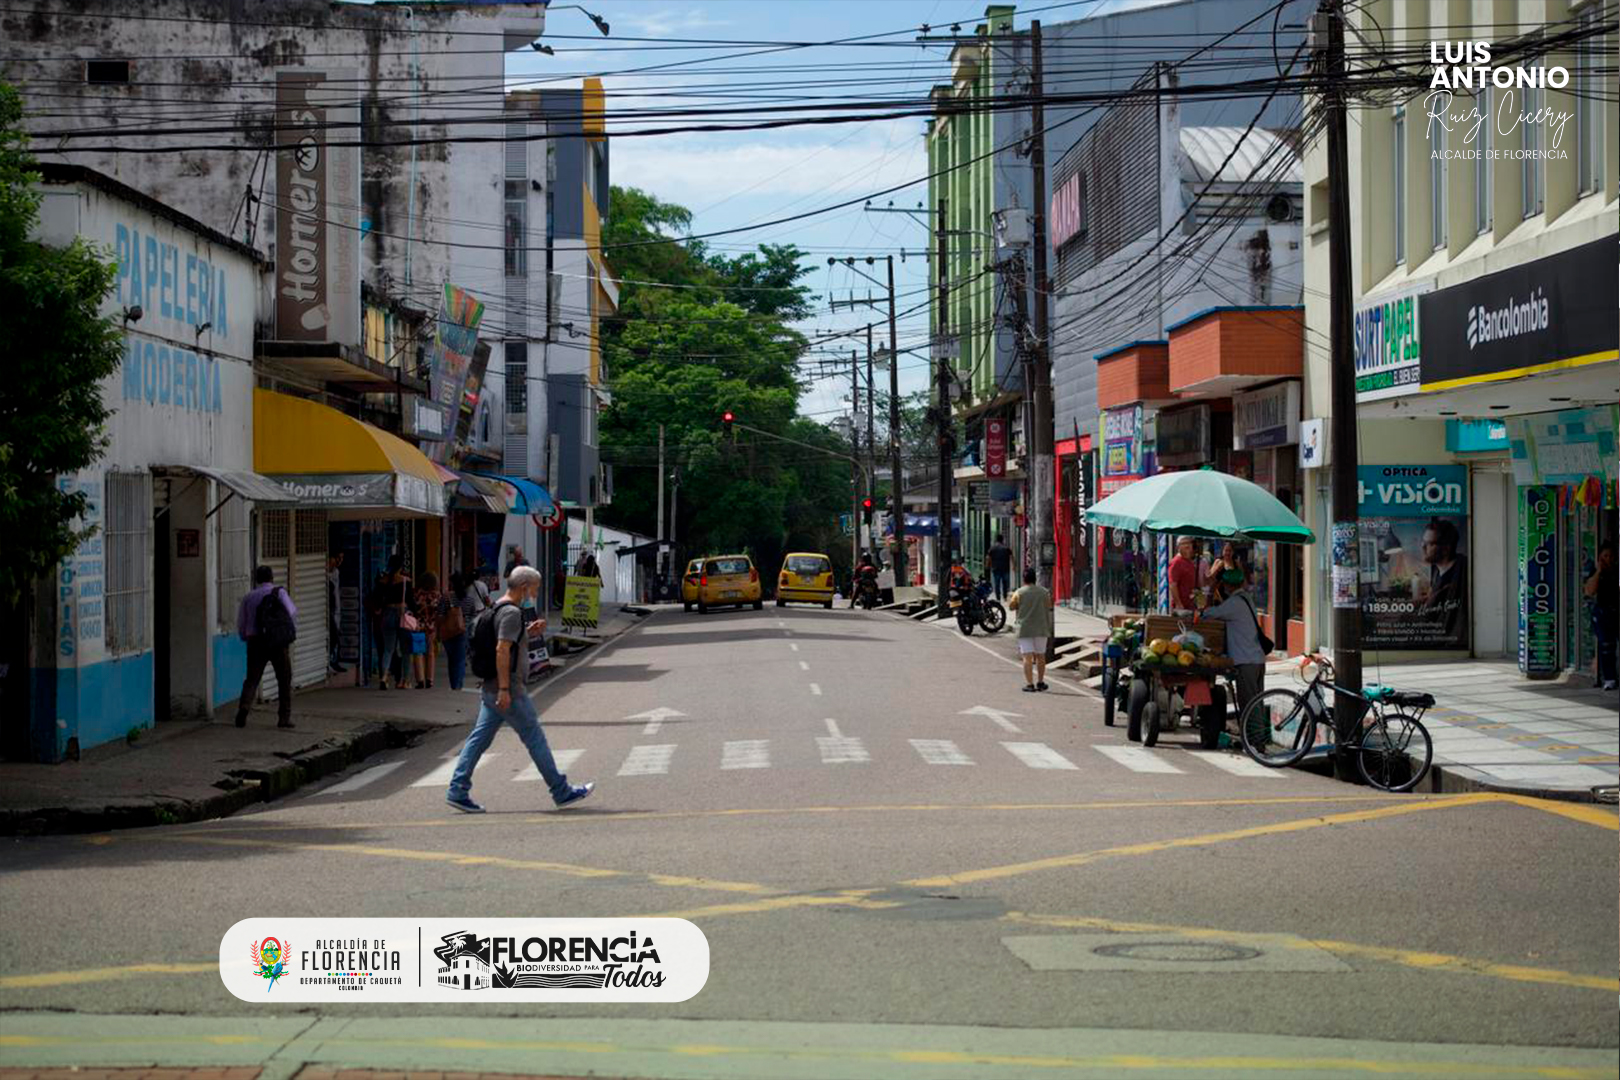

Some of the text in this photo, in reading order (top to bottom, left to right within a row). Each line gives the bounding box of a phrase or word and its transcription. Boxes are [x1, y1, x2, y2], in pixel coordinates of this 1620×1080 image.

[115, 222, 228, 338] PAPELERIA
[1478, 286, 1549, 345] Bancolombia
[1355, 294, 1418, 372] SURTIPAPEL
[122, 339, 222, 414] MODERNA
[1382, 467, 1428, 477] OPTICA
[1421, 505, 1460, 514] Colombia
[1534, 499, 1550, 615] OFICIOS
